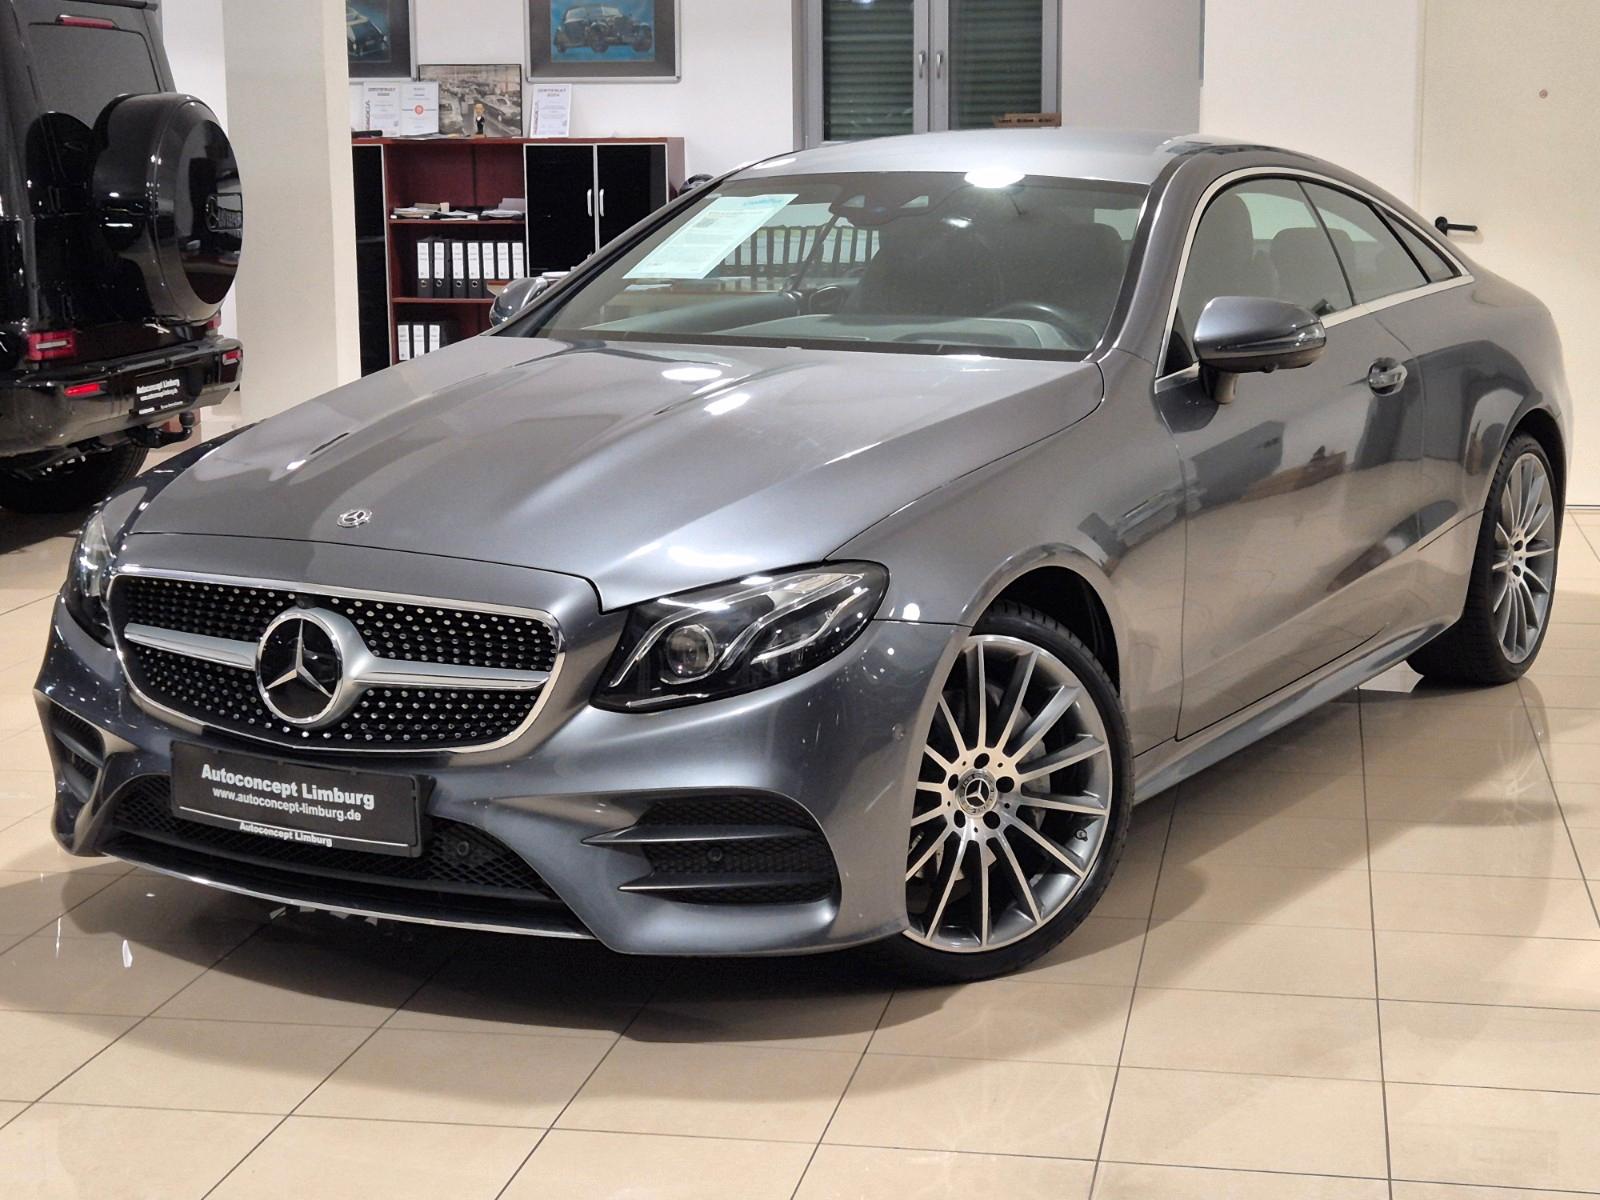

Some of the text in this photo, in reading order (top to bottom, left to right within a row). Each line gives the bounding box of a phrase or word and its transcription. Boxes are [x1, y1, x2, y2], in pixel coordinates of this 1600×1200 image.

[201, 763, 375, 810] Autoconcept Limburg
[212, 786, 362, 821] www.autoconcept-limburg.de
[239, 822, 333, 848] Autoconcept Limburg
